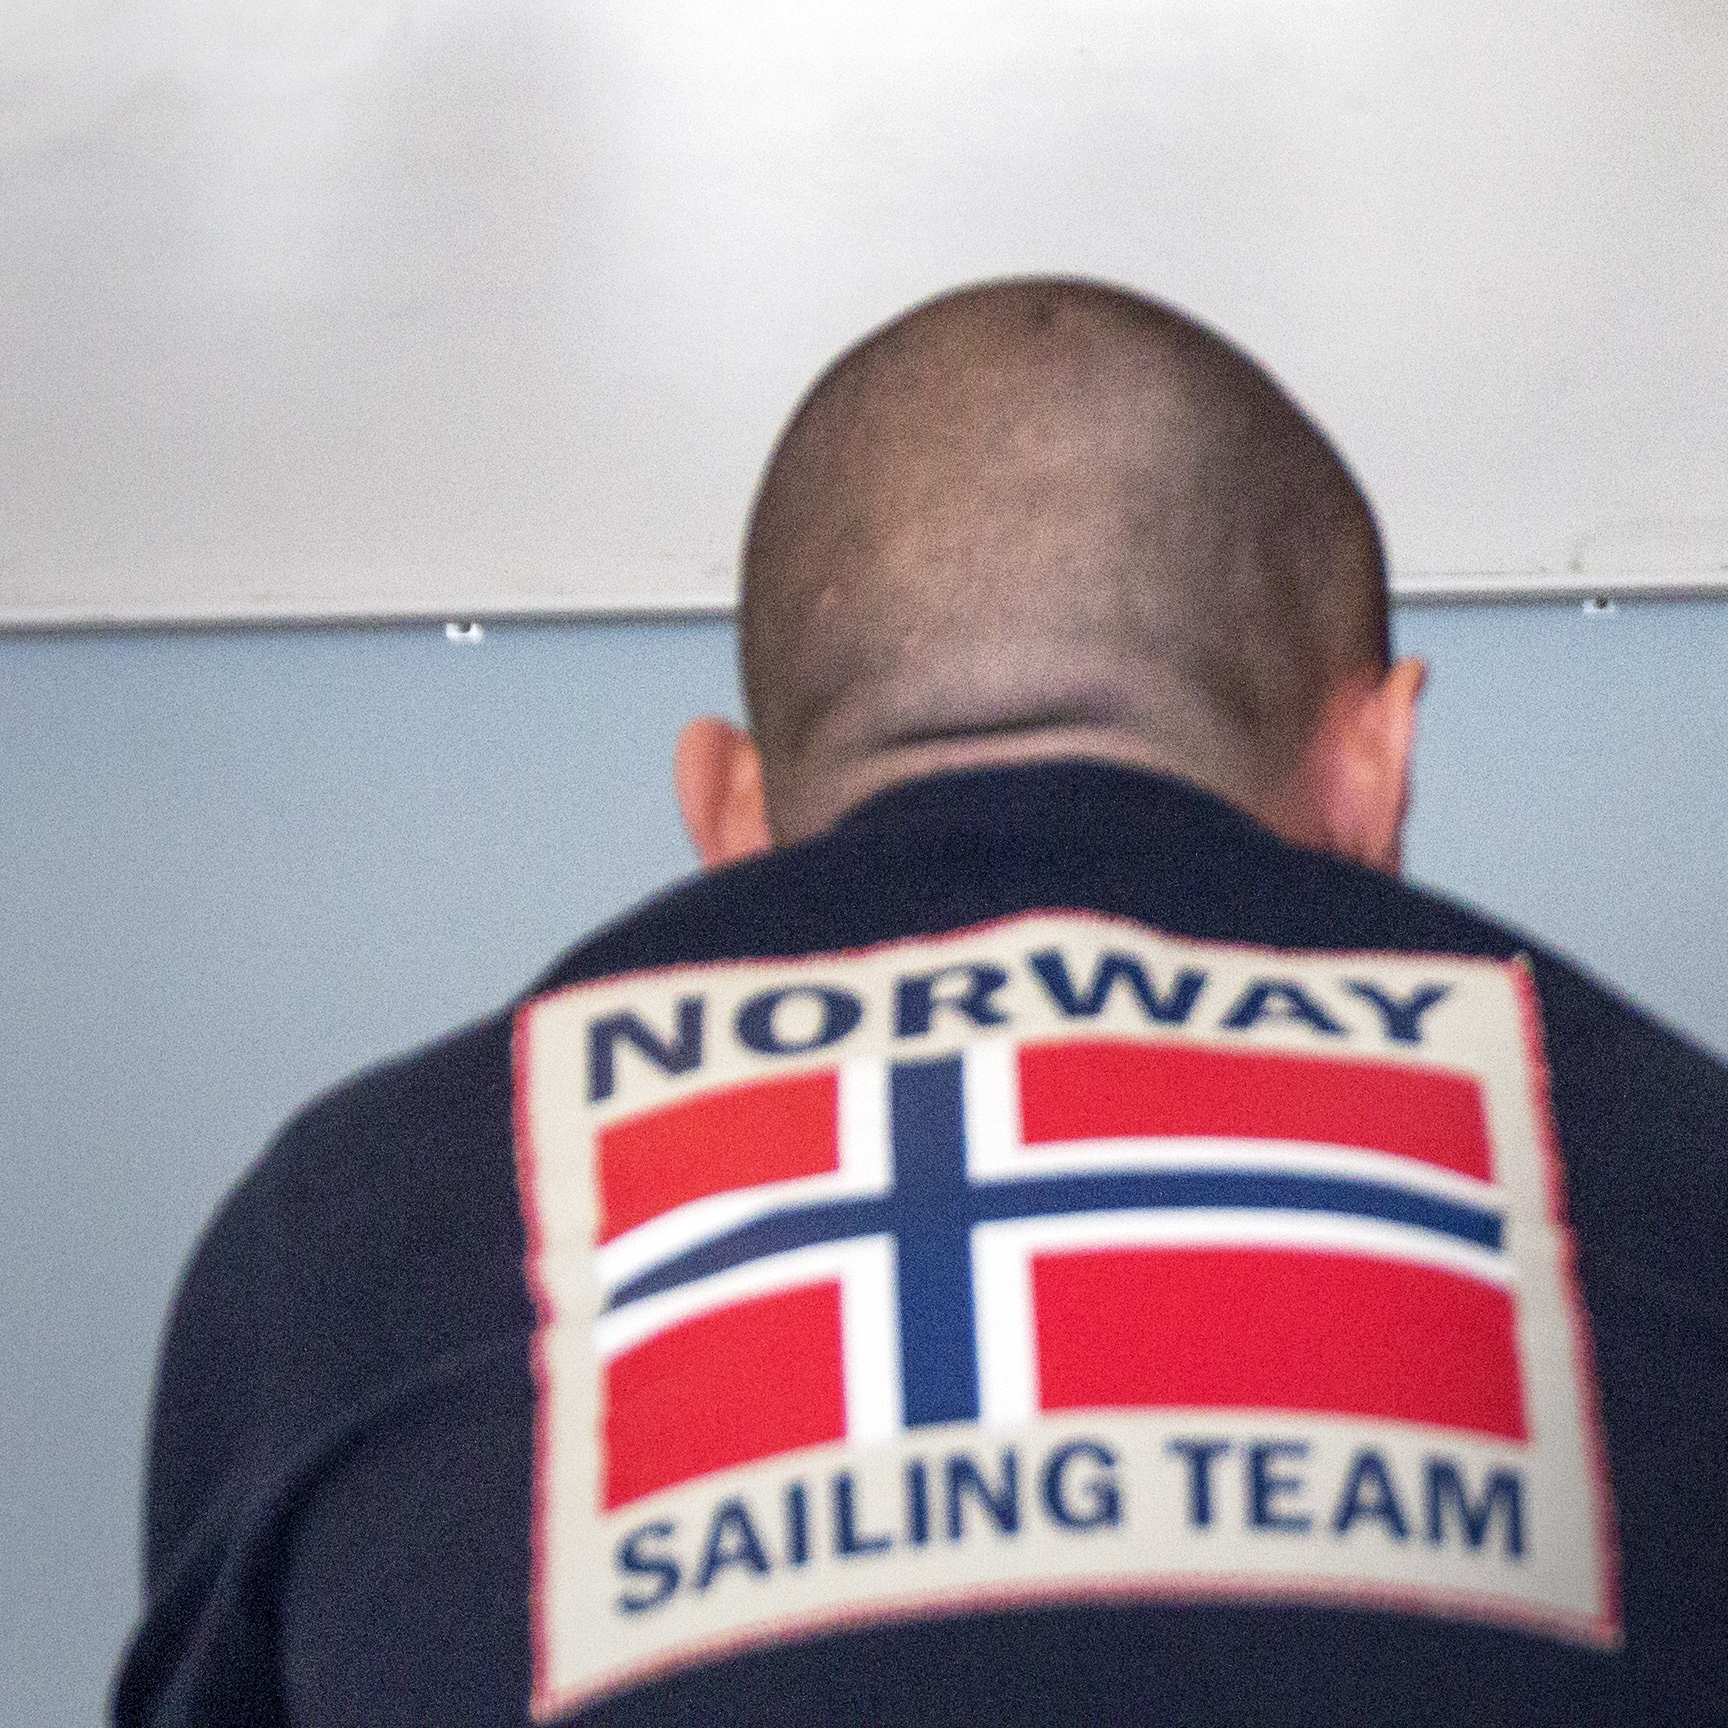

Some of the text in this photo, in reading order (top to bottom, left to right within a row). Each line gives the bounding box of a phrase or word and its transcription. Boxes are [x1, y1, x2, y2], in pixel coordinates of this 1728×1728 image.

[582, 944, 1456, 1105] NORWAY
[612, 1435, 1530, 1617] SAILING TEAM
